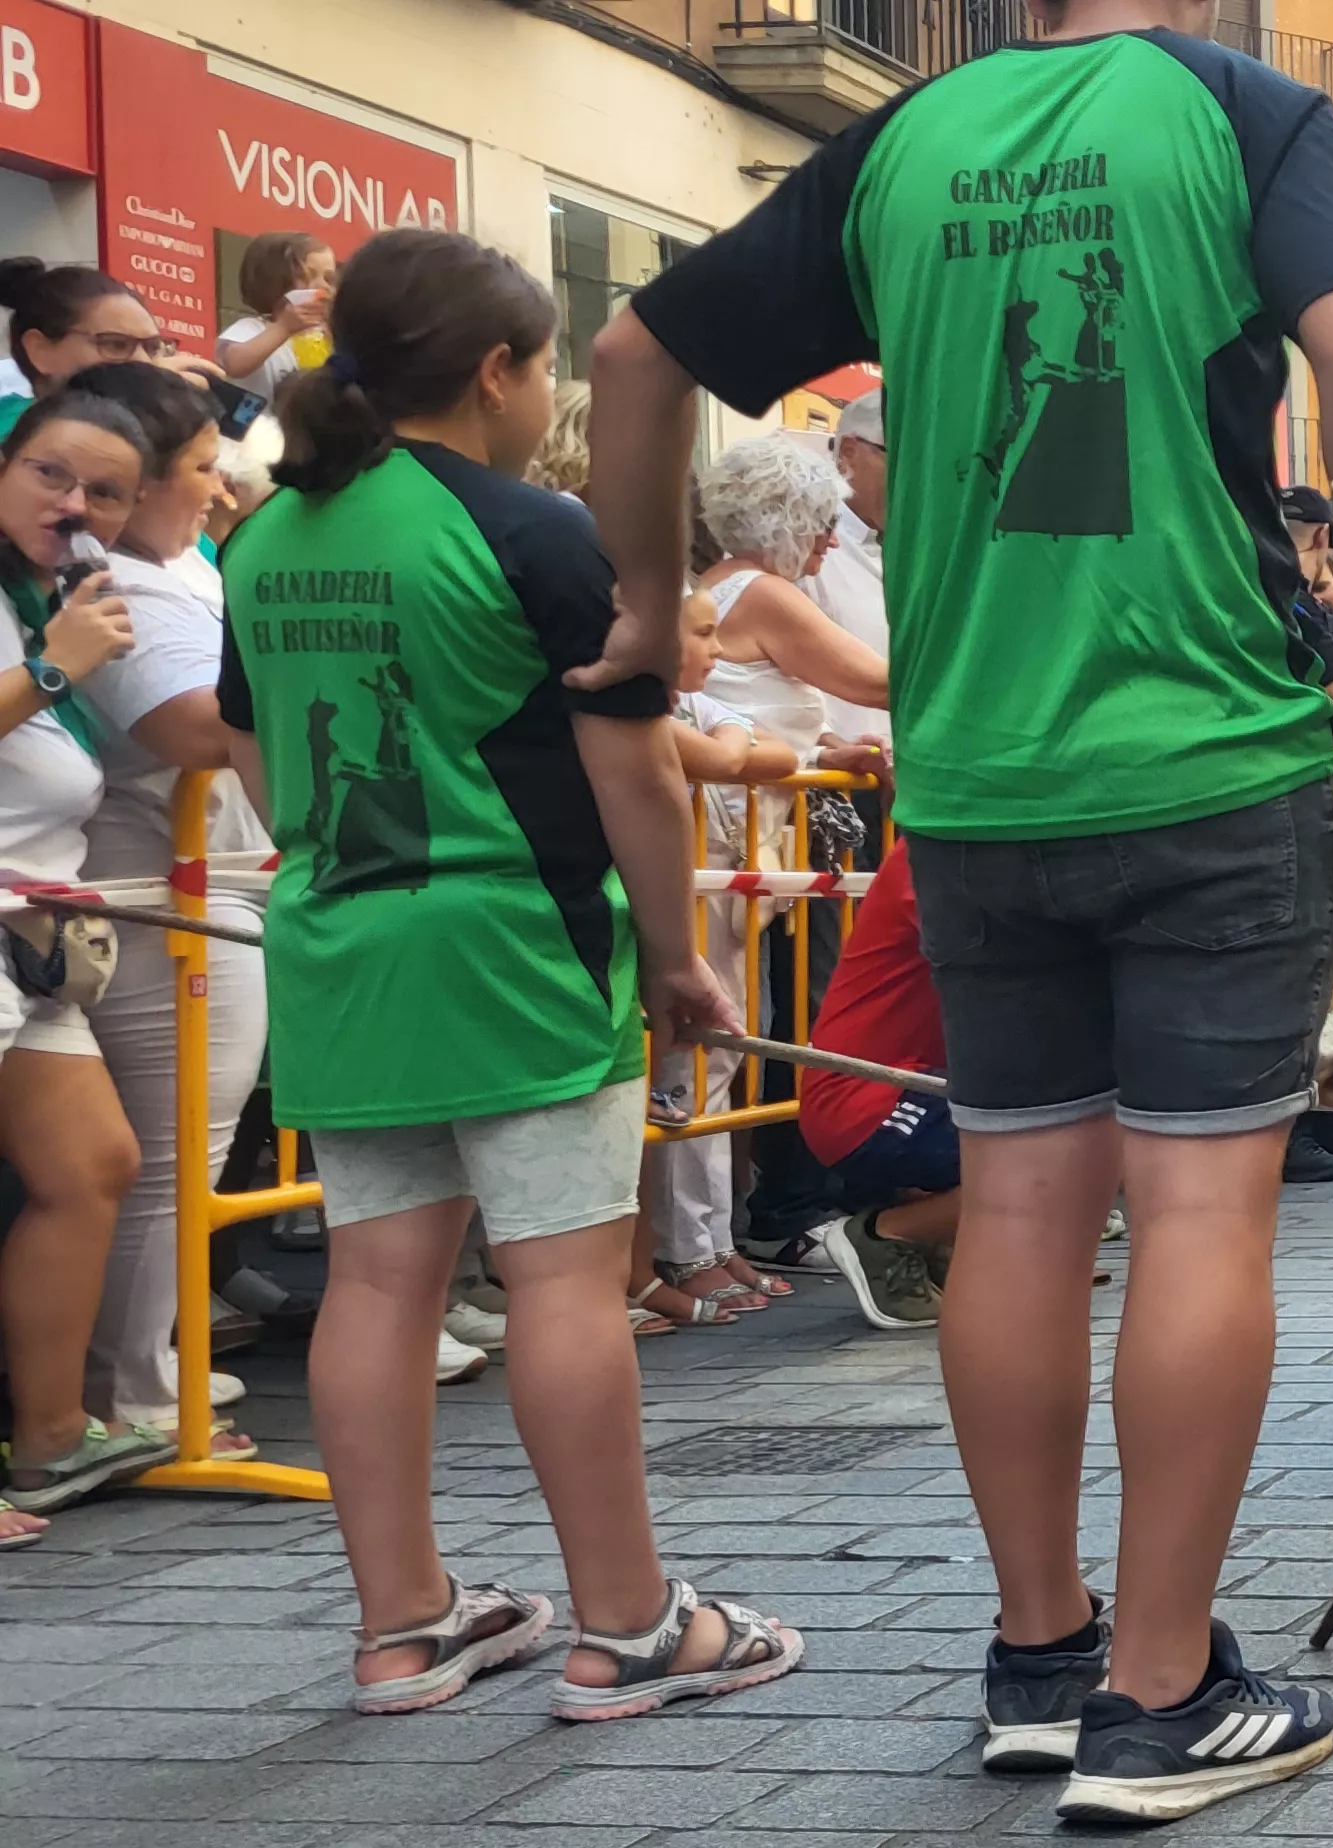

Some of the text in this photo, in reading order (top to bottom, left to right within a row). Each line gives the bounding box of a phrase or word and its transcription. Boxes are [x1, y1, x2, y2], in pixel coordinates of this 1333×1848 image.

[217, 128, 450, 232] VISIONLAB
[942, 221, 977, 260] EL
[131, 254, 178, 279] GUCCI
[255, 564, 394, 605] GANADERÍA
[252, 612, 400, 655] EL RUISEÑOR
